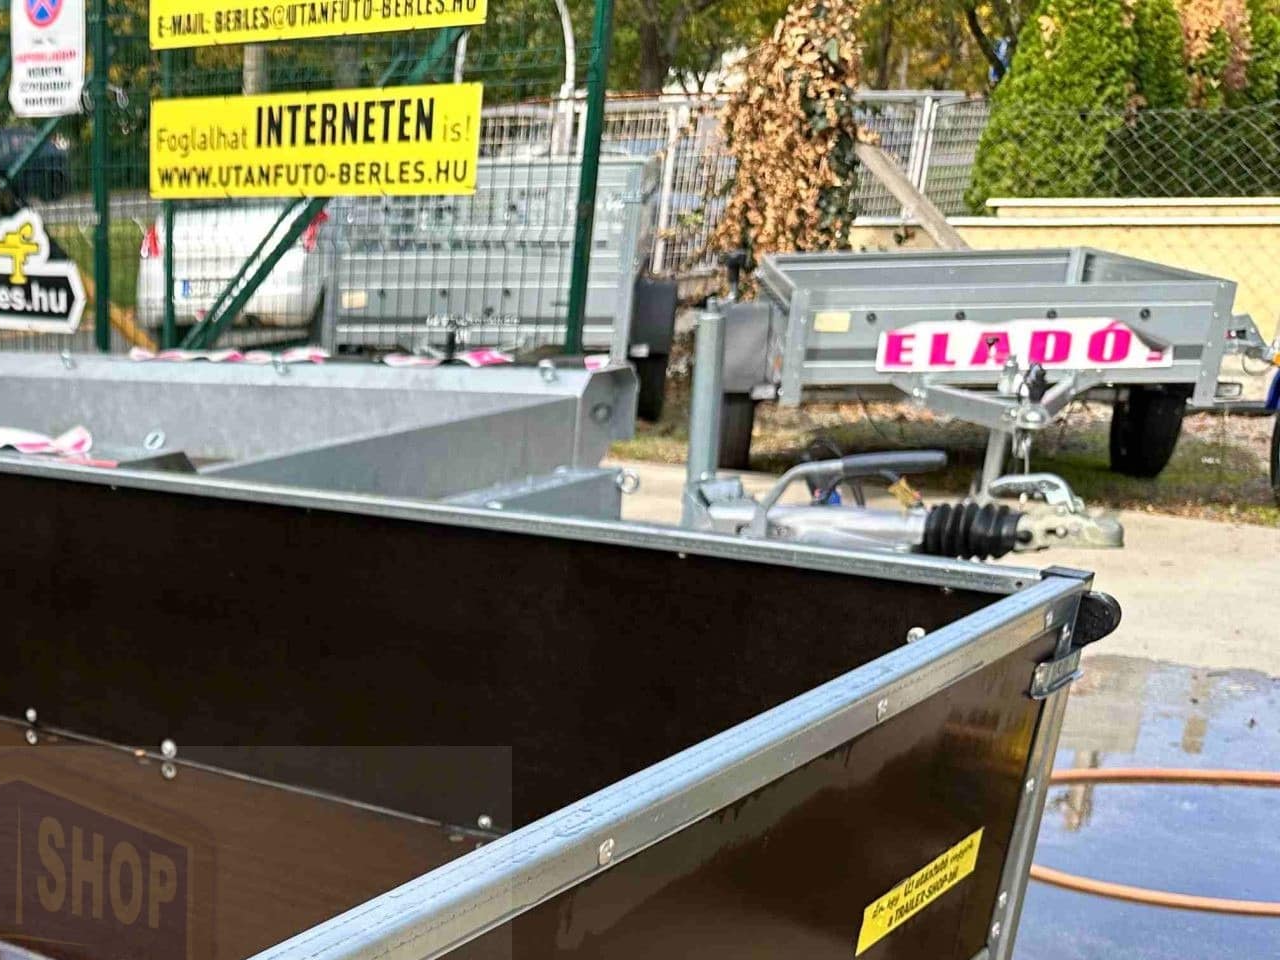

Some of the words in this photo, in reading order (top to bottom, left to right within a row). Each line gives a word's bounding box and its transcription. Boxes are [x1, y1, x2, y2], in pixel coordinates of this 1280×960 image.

[157, 125, 248, 158] Foglalhat
[256, 97, 435, 150] INTERNETEN
[442, 115, 471, 143] is!
[157, 160, 468, 189] WWW.UTANFUTO-BERLES.HU
[884, 320, 1163, 366] ELADÓ
